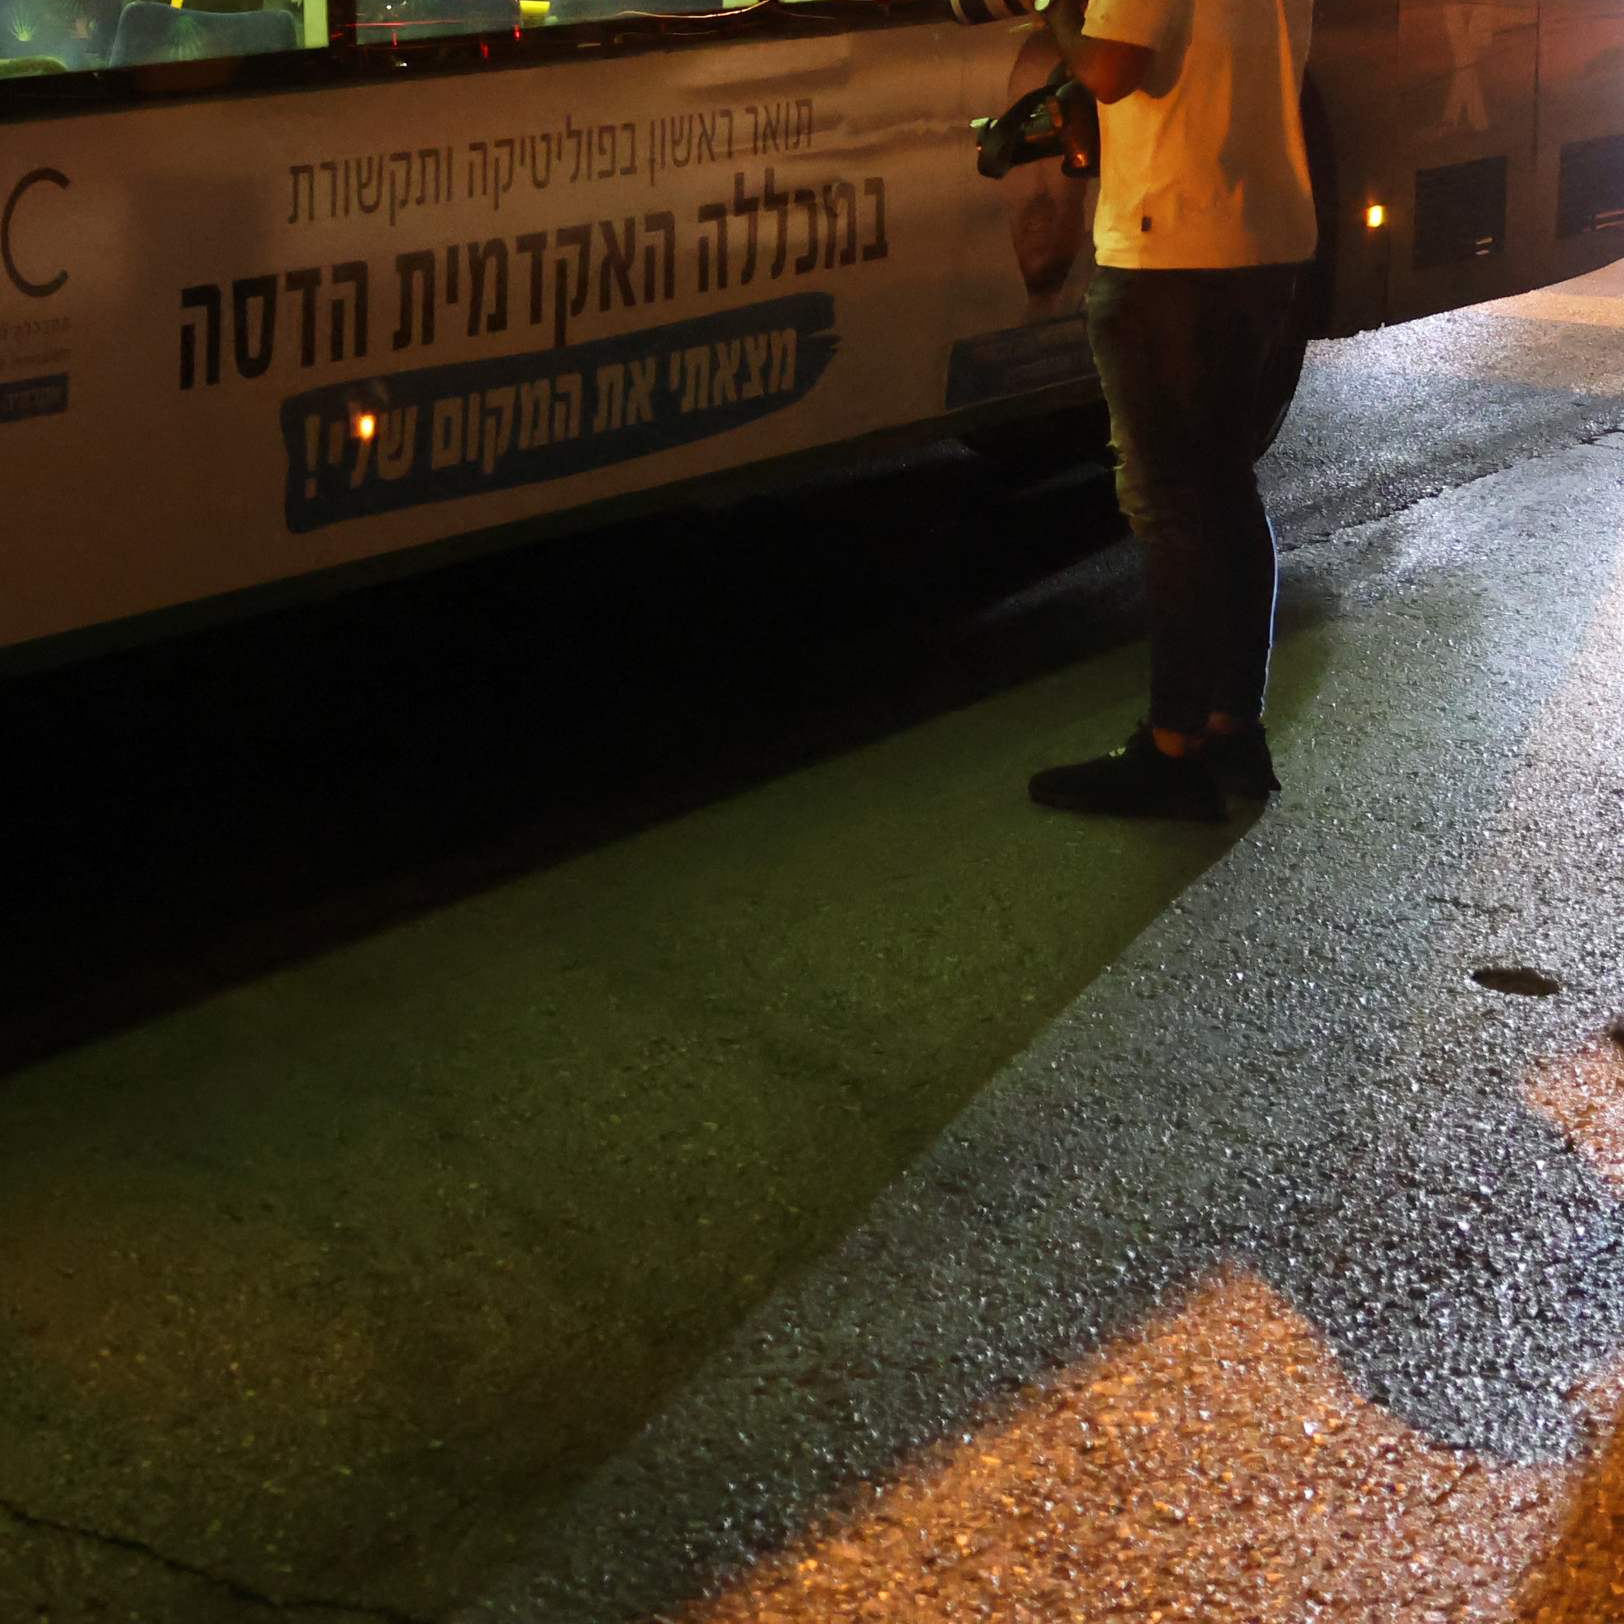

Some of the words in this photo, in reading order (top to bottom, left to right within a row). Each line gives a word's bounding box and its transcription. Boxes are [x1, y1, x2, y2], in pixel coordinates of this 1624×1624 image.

[467, 115, 638, 210] בפוליטיקה
[650, 107, 735, 185] ראשון
[751, 98, 813, 154] תואר
[288, 145, 454, 226] ותקשורת
[697, 168, 890, 293] במכללה
[178, 260, 370, 390] הדסה
[392, 209, 677, 352] האקדמית
[592, 356, 656, 431] את
[669, 327, 798, 414] מצאתי
[429, 371, 584, 477] המקום
